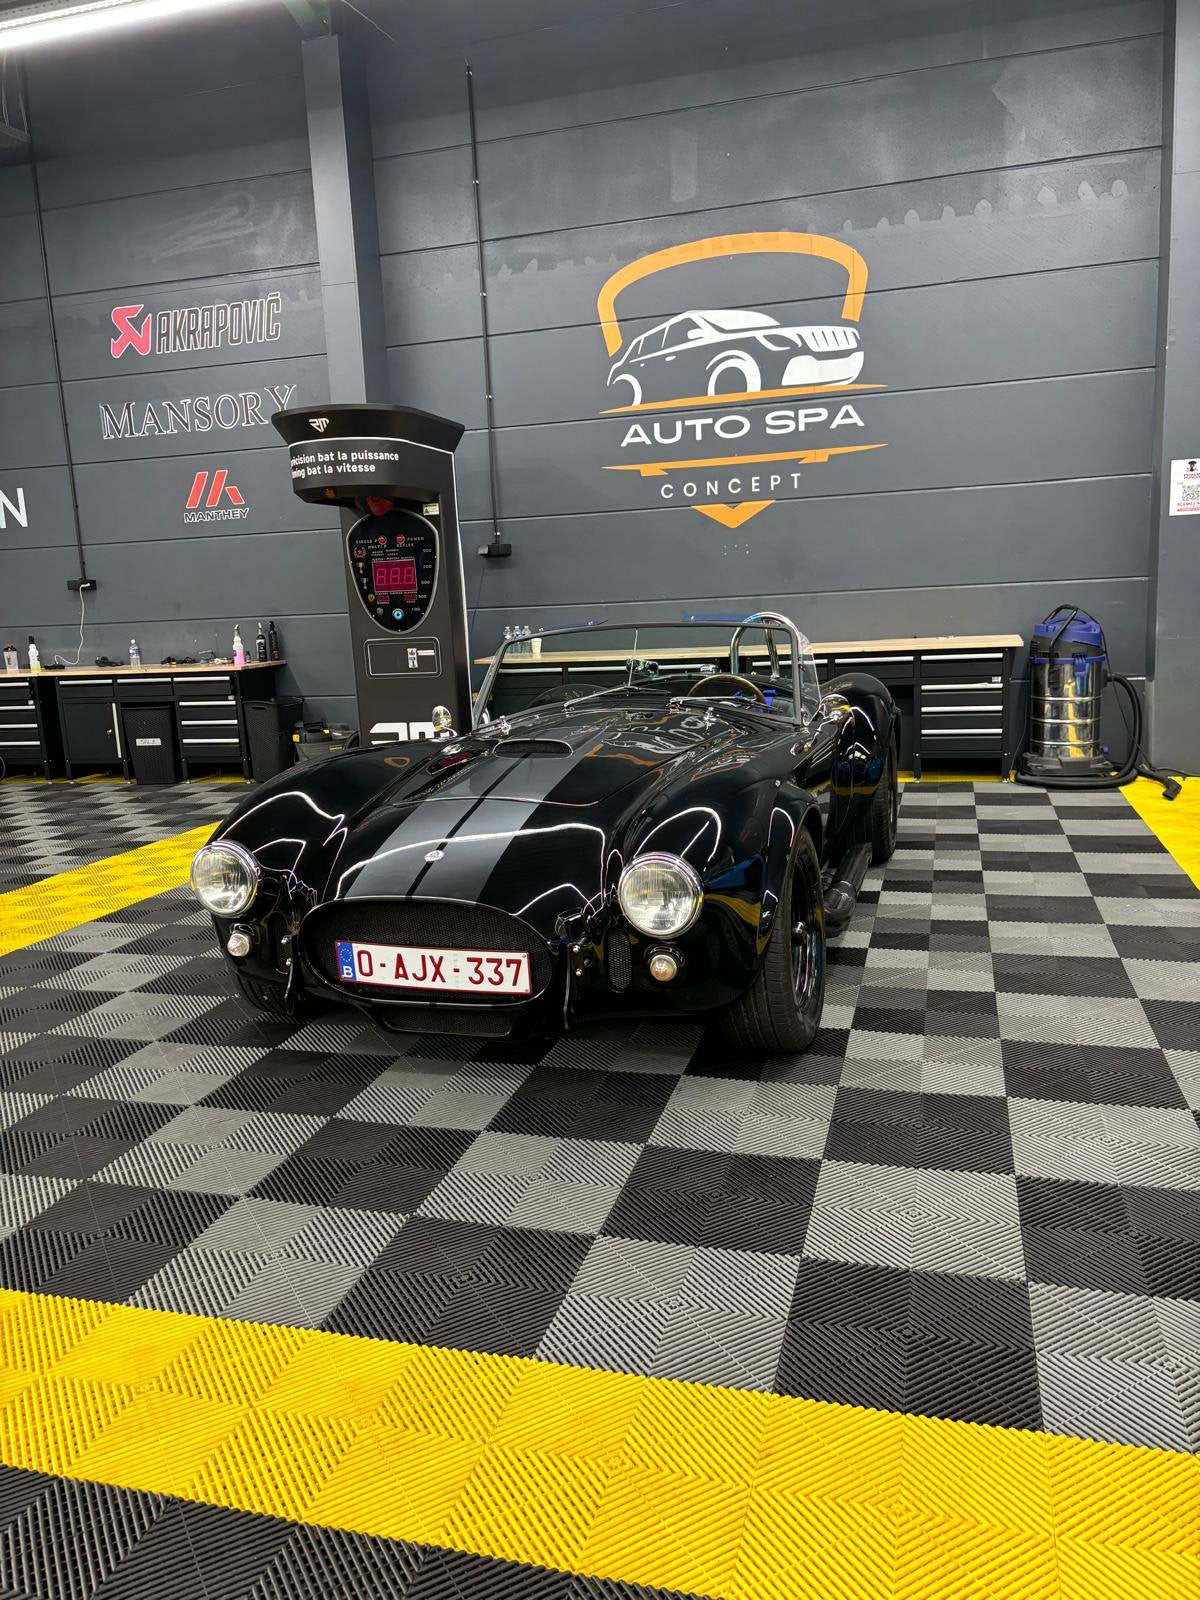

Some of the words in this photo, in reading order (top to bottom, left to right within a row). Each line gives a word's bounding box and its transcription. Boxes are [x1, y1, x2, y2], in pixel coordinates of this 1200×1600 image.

[156, 291, 281, 354] AKRAPOVIČ
[99, 384, 296, 440] MANSORY
[620, 415, 751, 447] AUTO
[765, 404, 865, 435] SPA
[317, 451, 335, 462] bat
[337, 451, 348, 461] la
[350, 450, 399, 462] puissance
[306, 464, 322, 476] bat
[323, 464, 334, 474] la
[336, 462, 376, 473] vitesse
[660, 473, 802, 499] CONCEPT
[184, 508, 250, 523] MANTHEY
[342, 965, 354, 978] B
